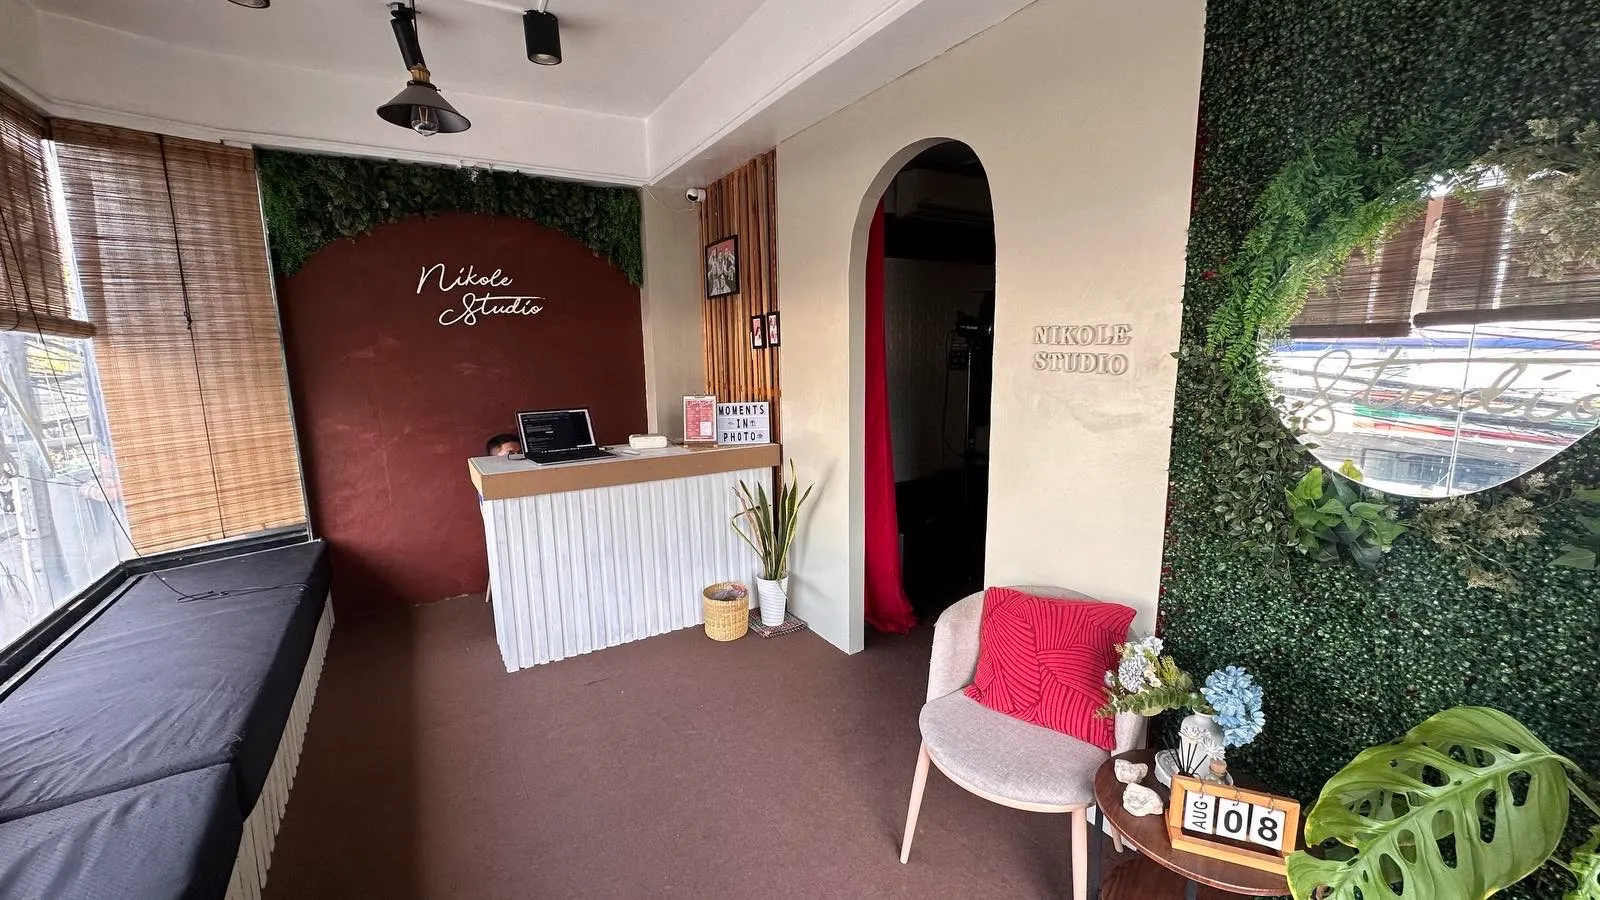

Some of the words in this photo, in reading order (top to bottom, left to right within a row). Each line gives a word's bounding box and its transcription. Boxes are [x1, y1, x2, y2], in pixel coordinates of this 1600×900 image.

[416, 263, 513, 294] Nikole
[438, 292, 546, 326] Studio
[1033, 323, 1132, 345] NIKOLE
[1034, 351, 1128, 375] STUDIO
[718, 405, 764, 415] MOMENTS
[736, 418, 748, 428] IN
[723, 431, 756, 442] PHOTO
[1192, 801, 1208, 830] AUG
